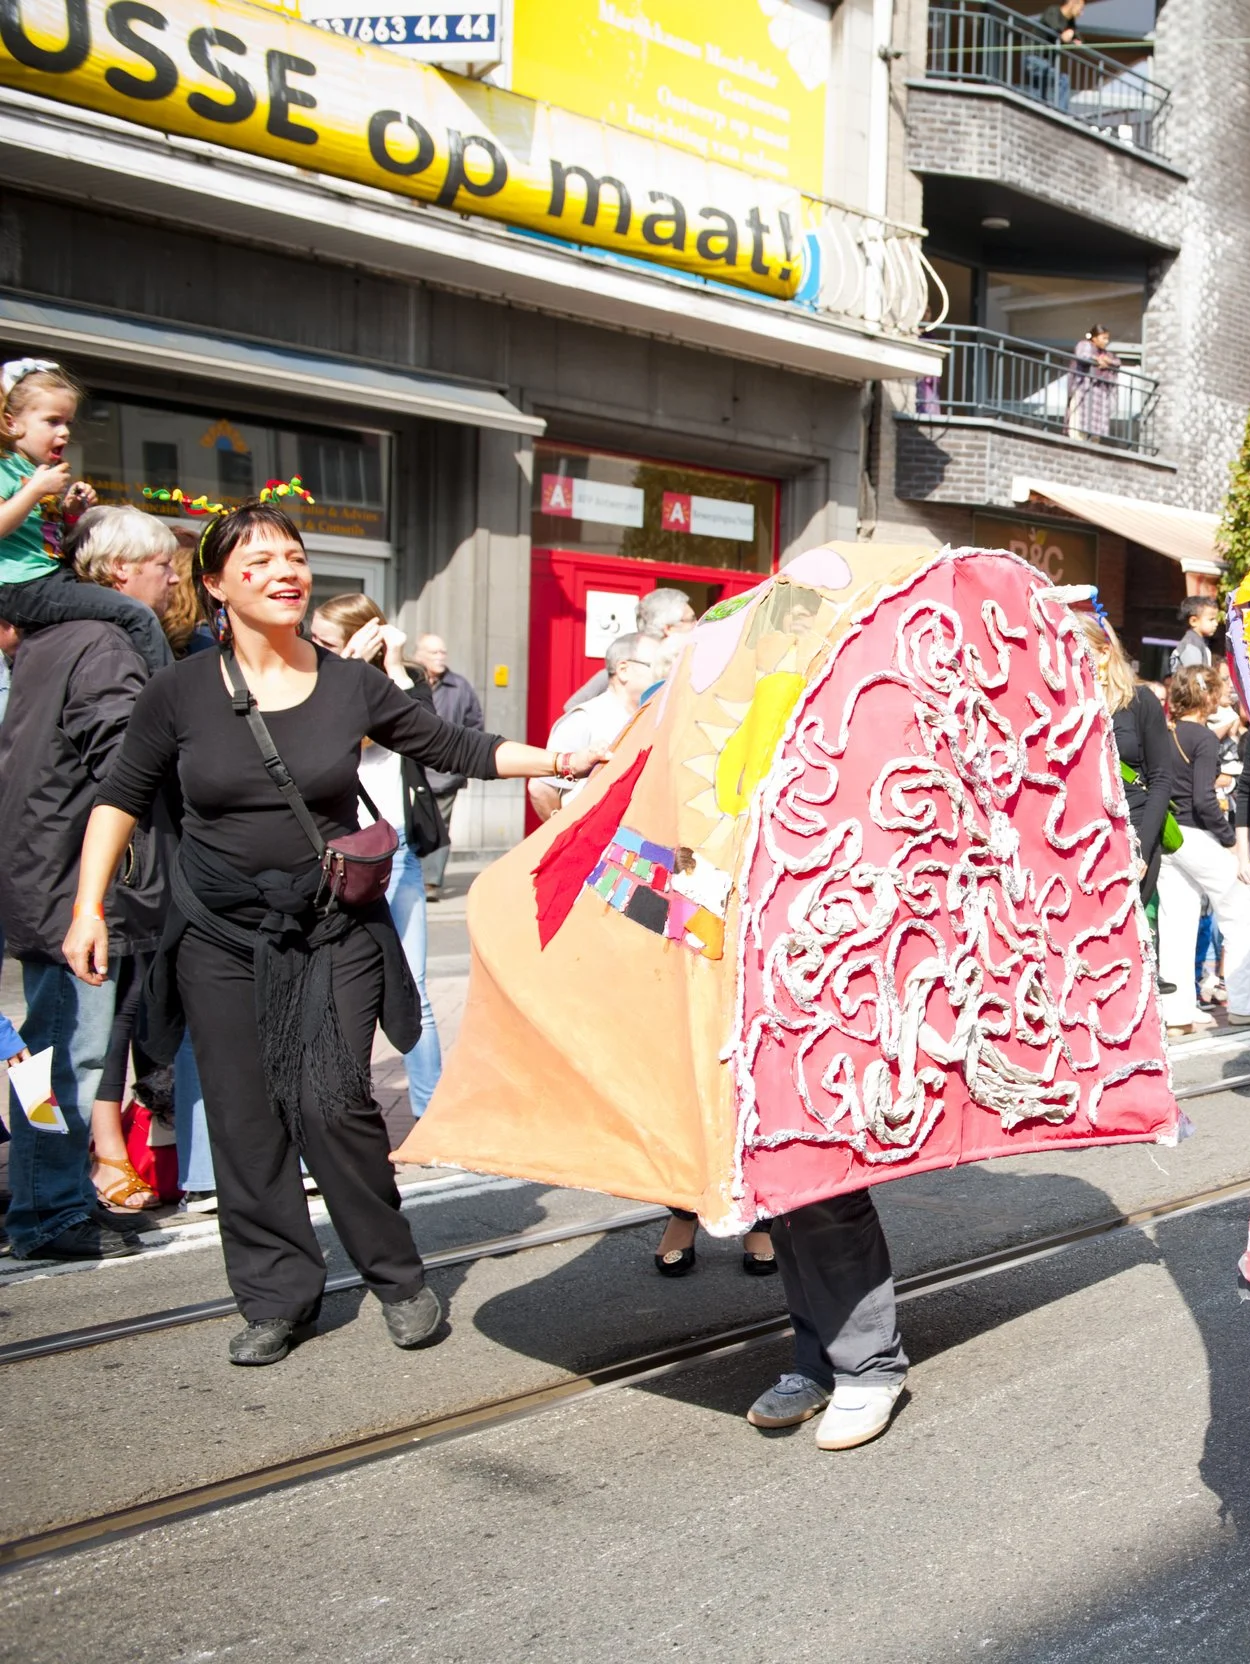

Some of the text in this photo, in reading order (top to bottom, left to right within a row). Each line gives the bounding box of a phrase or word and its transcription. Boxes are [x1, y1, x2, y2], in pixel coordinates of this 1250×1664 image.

[414, 14, 448, 41] 44
[455, 13, 490, 40] 44
[368, 109, 508, 206] op
[547, 158, 792, 281] maat!
